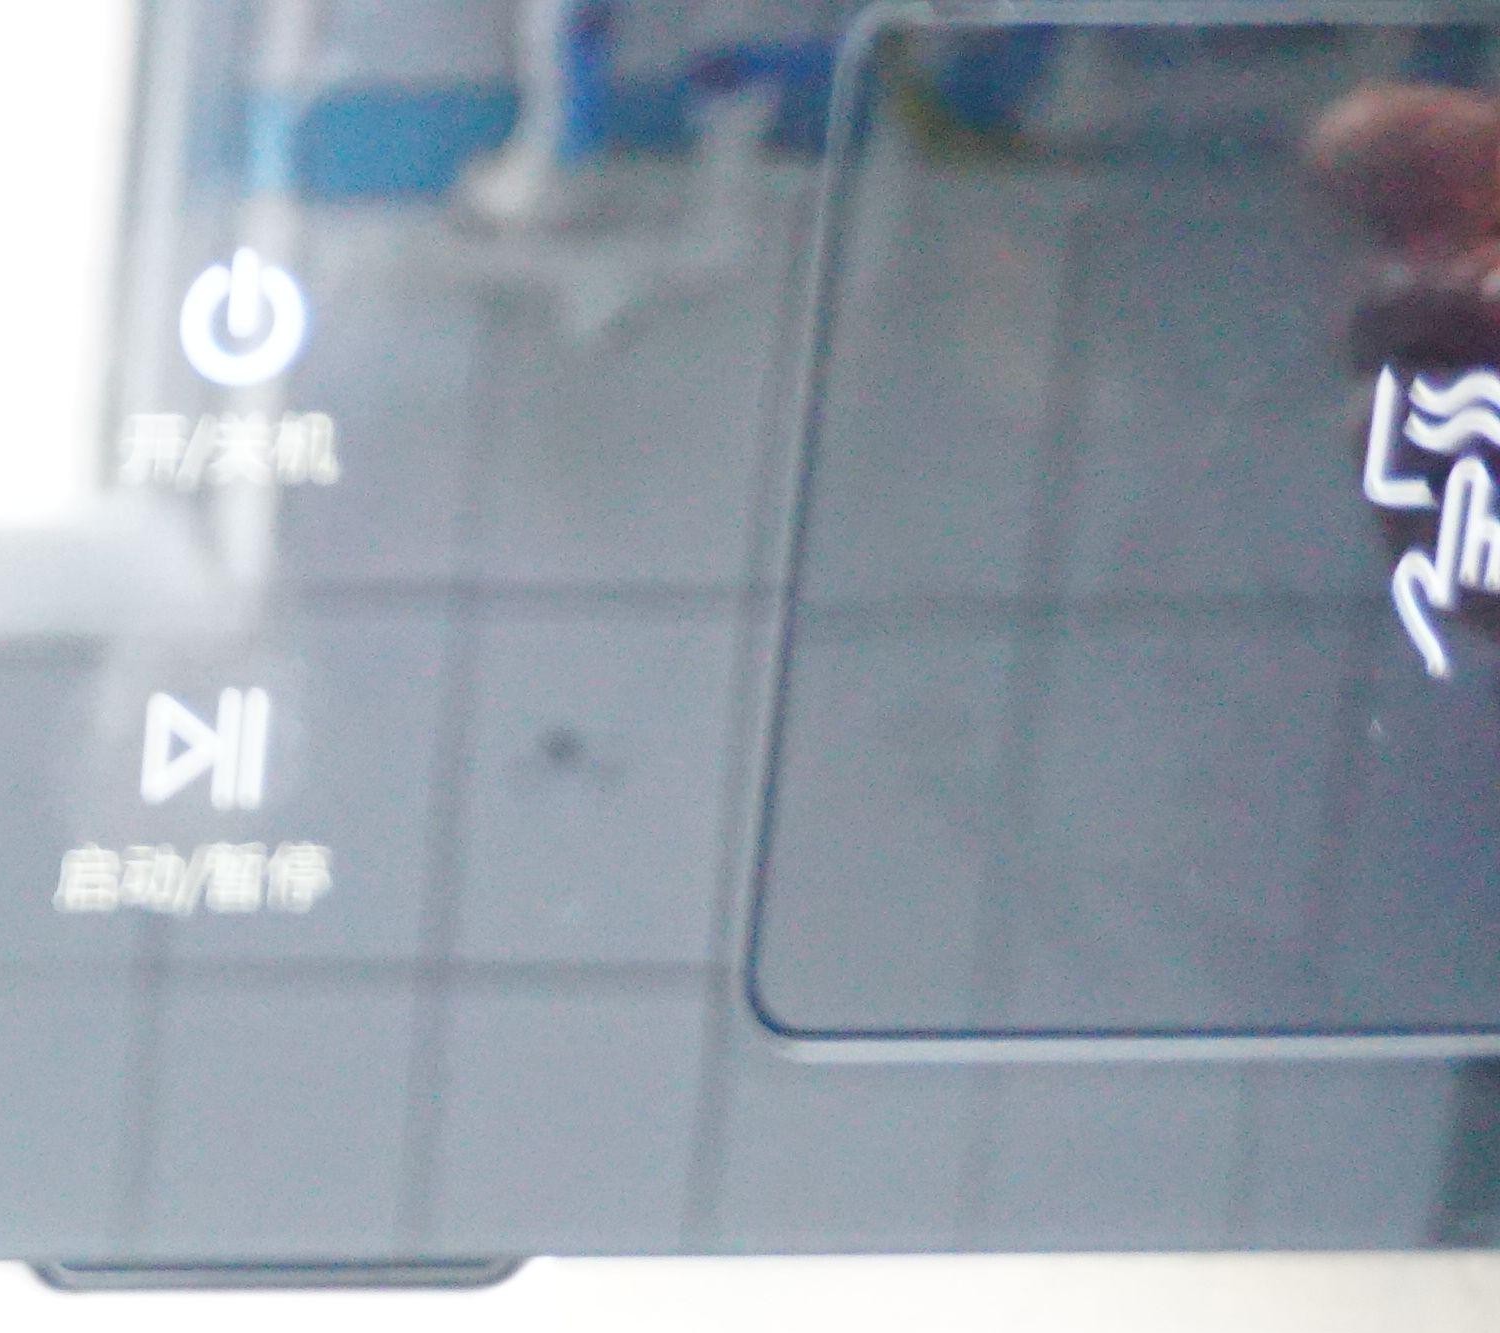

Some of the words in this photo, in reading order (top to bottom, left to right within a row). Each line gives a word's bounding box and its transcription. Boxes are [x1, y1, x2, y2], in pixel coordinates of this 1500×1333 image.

[116, 411, 340, 488] 开/关机
[52, 842, 334, 916] 启动/暂停
